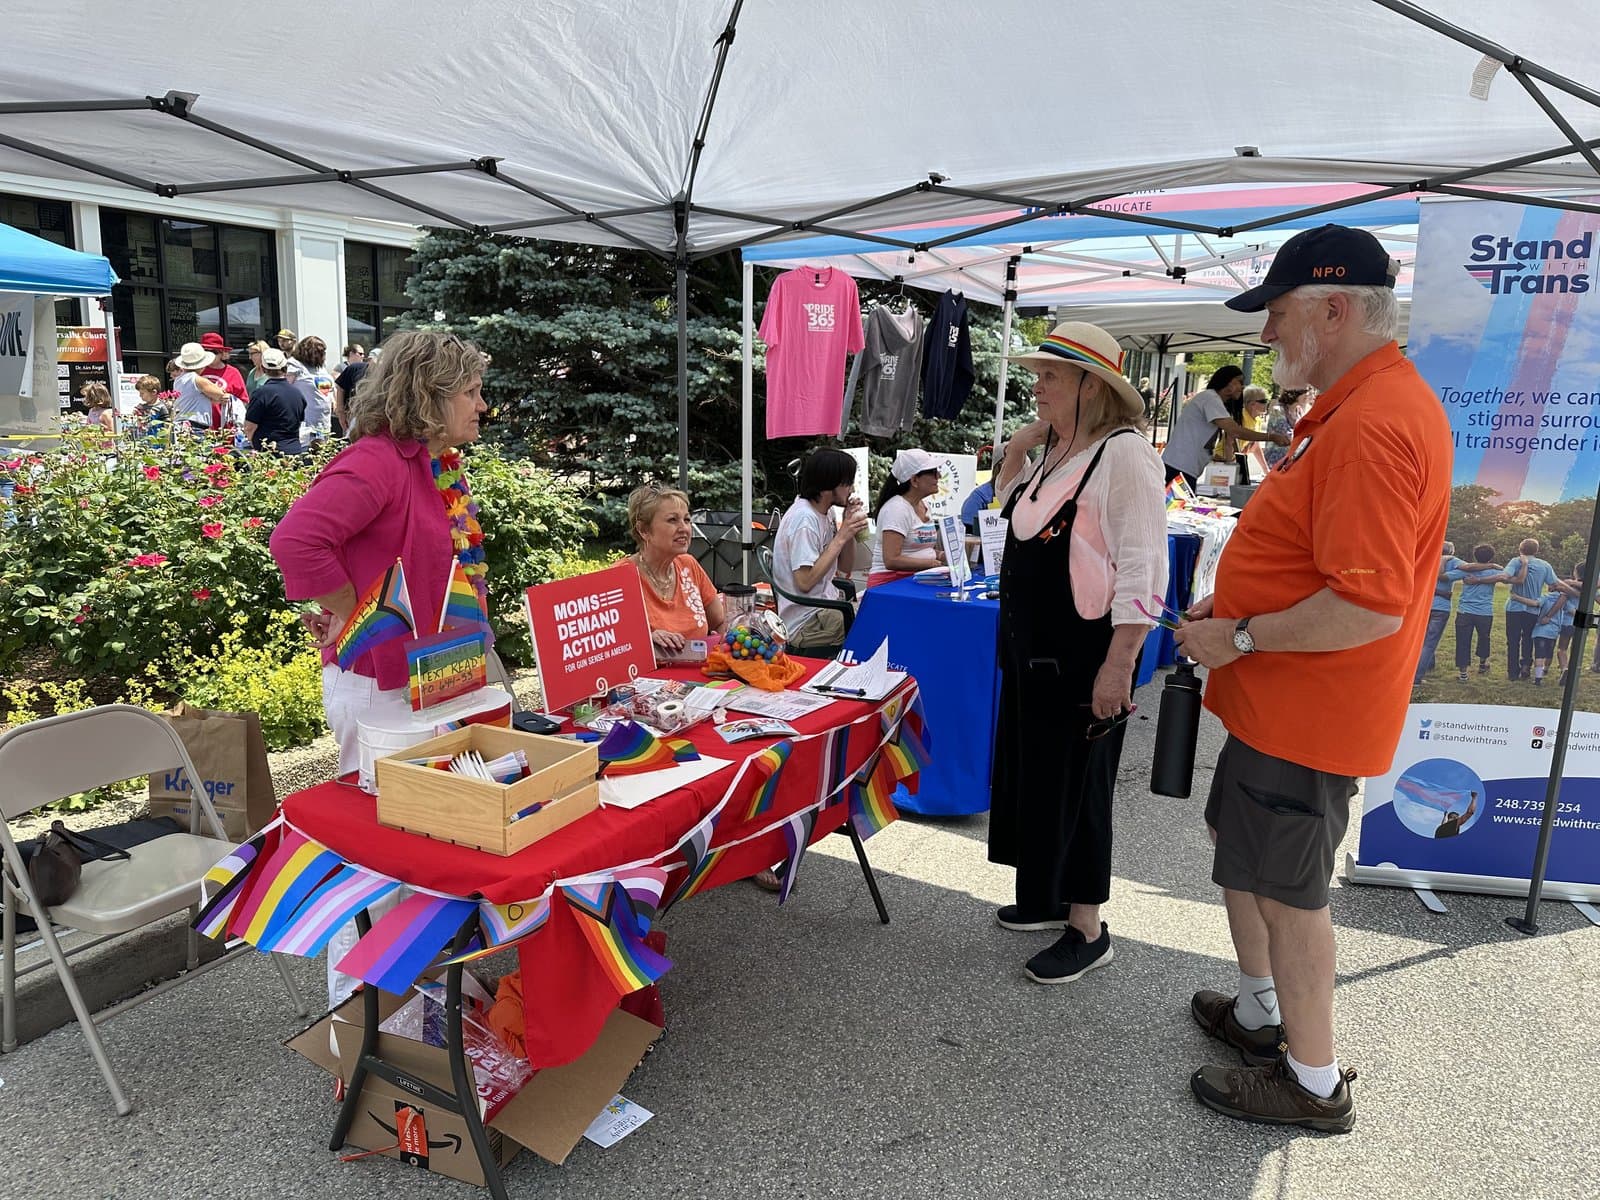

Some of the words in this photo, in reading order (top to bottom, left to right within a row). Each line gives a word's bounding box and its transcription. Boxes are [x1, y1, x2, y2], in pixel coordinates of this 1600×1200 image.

[1469, 231, 1593, 262] Stand
[1312, 266, 1346, 278] NPO
[1466, 266, 1590, 295] Trans
[806, 303, 835, 314] PRIDE
[807, 312, 835, 327] 365
[1440, 386, 1526, 408] Together,
[1531, 392, 1561, 405] we
[1467, 411, 1535, 430] stigma
[1465, 432, 1588, 454] transgender
[553, 593, 600, 622] MOMS
[557, 608, 620, 641] DEMAND
[562, 628, 616, 661] ACTION
[564, 660, 576, 673] FOR
[576, 656, 588, 671] GUN
[587, 653, 605, 667] SENSE
[604, 651, 611, 660] IN
[610, 643, 633, 658] AMERICA
[421, 668, 446, 683] TEXT
[1434, 720, 1509, 734] @standwithtrans
[1433, 733, 1508, 746] @standwithtrans
[165, 767, 234, 801] Krger
